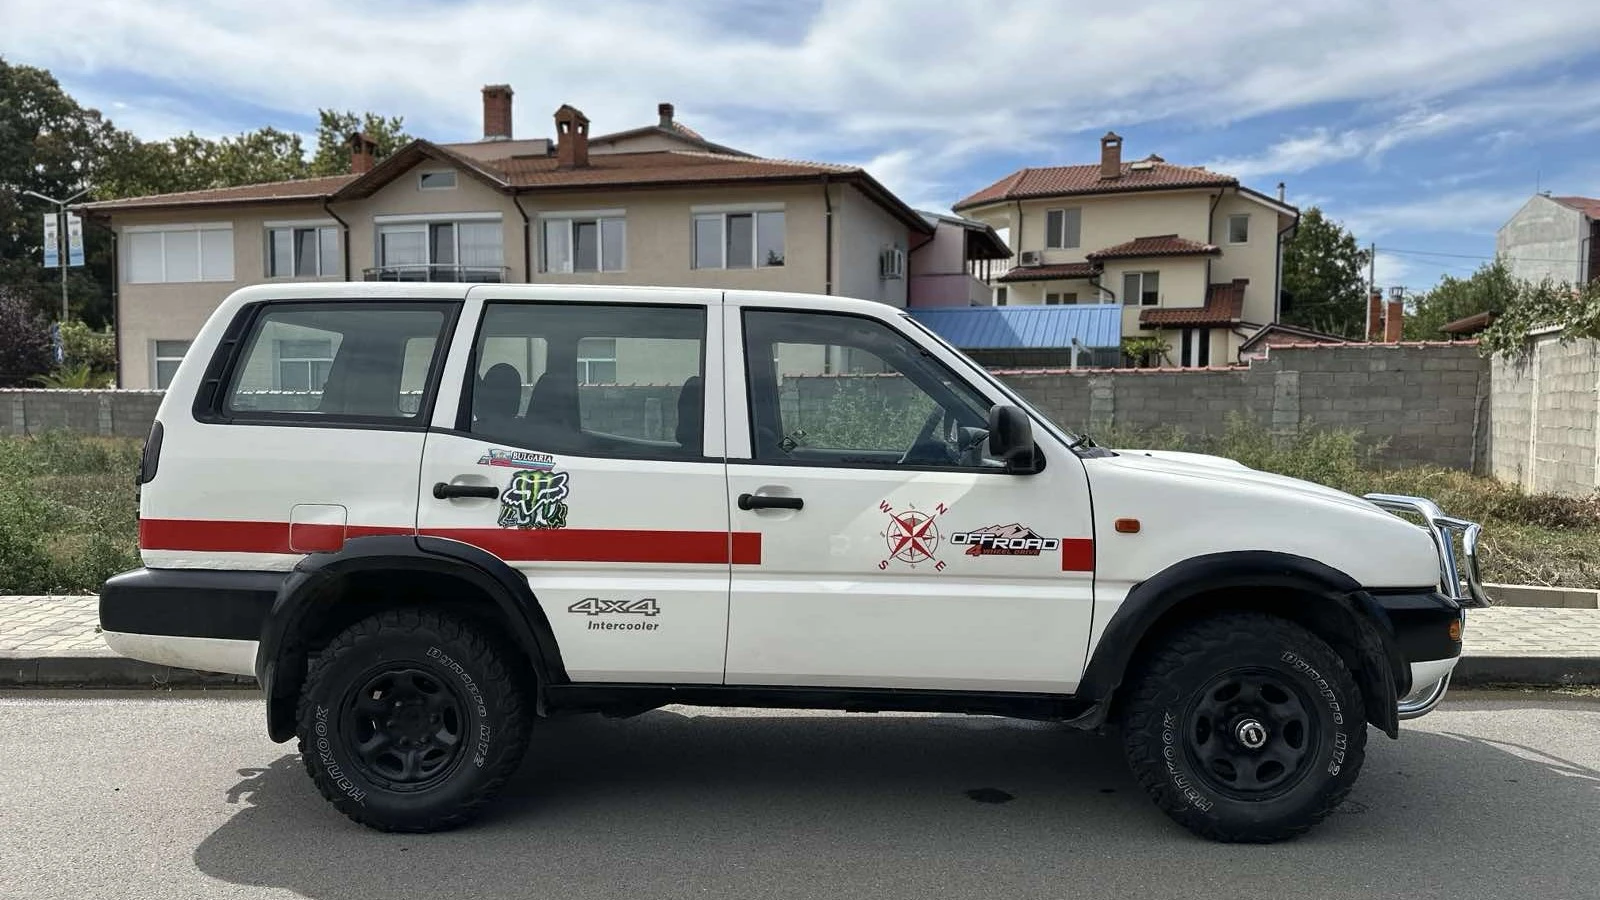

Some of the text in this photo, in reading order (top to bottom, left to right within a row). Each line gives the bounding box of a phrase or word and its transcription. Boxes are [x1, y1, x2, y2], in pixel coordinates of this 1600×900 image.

[512, 451, 553, 463] BULGARIA
[879, 499, 893, 514] W
[935, 502, 948, 515] N
[950, 532, 1060, 551] OFFROAD
[878, 560, 889, 571] S
[935, 560, 947, 572] E
[567, 597, 661, 617] 4x4
[587, 620, 660, 631] Intercooler
[426, 646, 491, 769] Dynapro MT2
[1327, 732, 1347, 777] MT2
